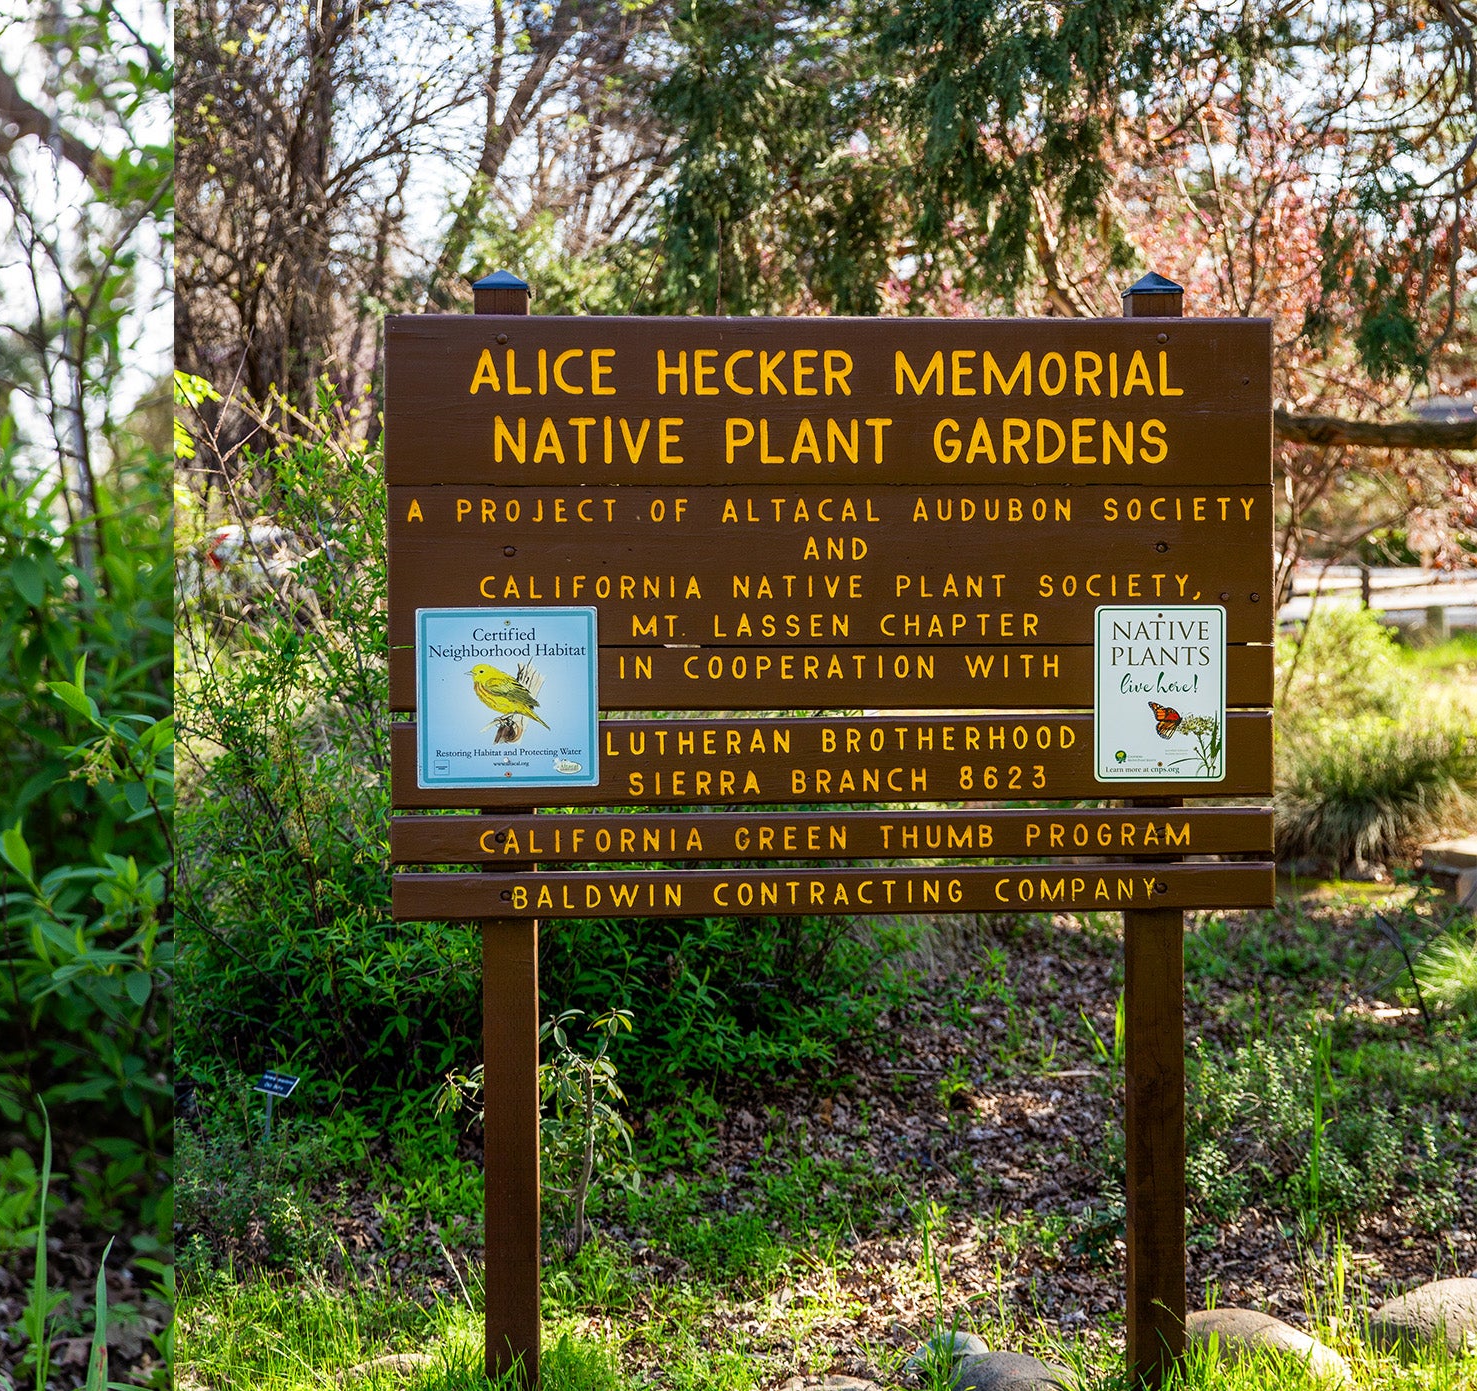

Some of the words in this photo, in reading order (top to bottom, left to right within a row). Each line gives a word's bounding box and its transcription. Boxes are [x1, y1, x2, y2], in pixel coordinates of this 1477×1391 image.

[469, 348, 617, 396] ALICE
[656, 349, 854, 397] HECKER
[894, 349, 1185, 399] MEMORIAL
[493, 415, 684, 465] NATIVE
[725, 417, 893, 465] PLANT
[933, 416, 1169, 466] GARDENS
[407, 498, 424, 523] A
[456, 498, 617, 524] PROJECT
[650, 498, 688, 523] OF
[721, 497, 880, 523] ALTACAL
[912, 497, 1071, 523] AUDUBON
[1103, 497, 1255, 522] SOCIETY
[803, 536, 868, 561] AND
[479, 574, 702, 600] CALIFORNIA
[733, 574, 863, 600] NATIVE
[896, 573, 1006, 598] PLANT
[1038, 573, 1201, 601] SOCIETY,
[472, 627, 537, 642] Certified
[632, 614, 686, 638] MT.
[714, 612, 849, 638] LASSEN
[879, 612, 1039, 638] CHAPTER
[1111, 620, 1210, 641] NATIVE
[428, 644, 531, 662] Neighborhood
[535, 643, 587, 657] Habitat
[1111, 646, 1211, 666] PLANTS
[619, 655, 652, 680] IN
[683, 654, 934, 680] COOPERATION
[964, 654, 1059, 679] WITH
[1120, 672, 1154, 695] live
[1155, 671, 1199, 693] here!
[435, 749, 472, 759] Restoring
[473, 749, 502, 757] Habitat
[503, 748, 518, 756] and
[519, 748, 558, 757] Protecting
[559, 747, 582, 755] Water
[606, 728, 790, 756] LUTHERAN
[821, 725, 1076, 754] BROTHERHOOD
[628, 769, 761, 796] SIERRA
[791, 767, 927, 794] BRANCH
[959, 765, 1046, 790] 8623
[1150, 766, 1180, 774] cnps.org
[479, 827, 703, 855] CALIFORNIA
[734, 825, 847, 851] GREEN
[879, 824, 994, 849] THUMB
[1026, 821, 1191, 848] PROGRAM
[513, 883, 682, 910] BALDWIN
[713, 879, 963, 907] CONTRACTING
[994, 877, 1156, 903] COMPANY
